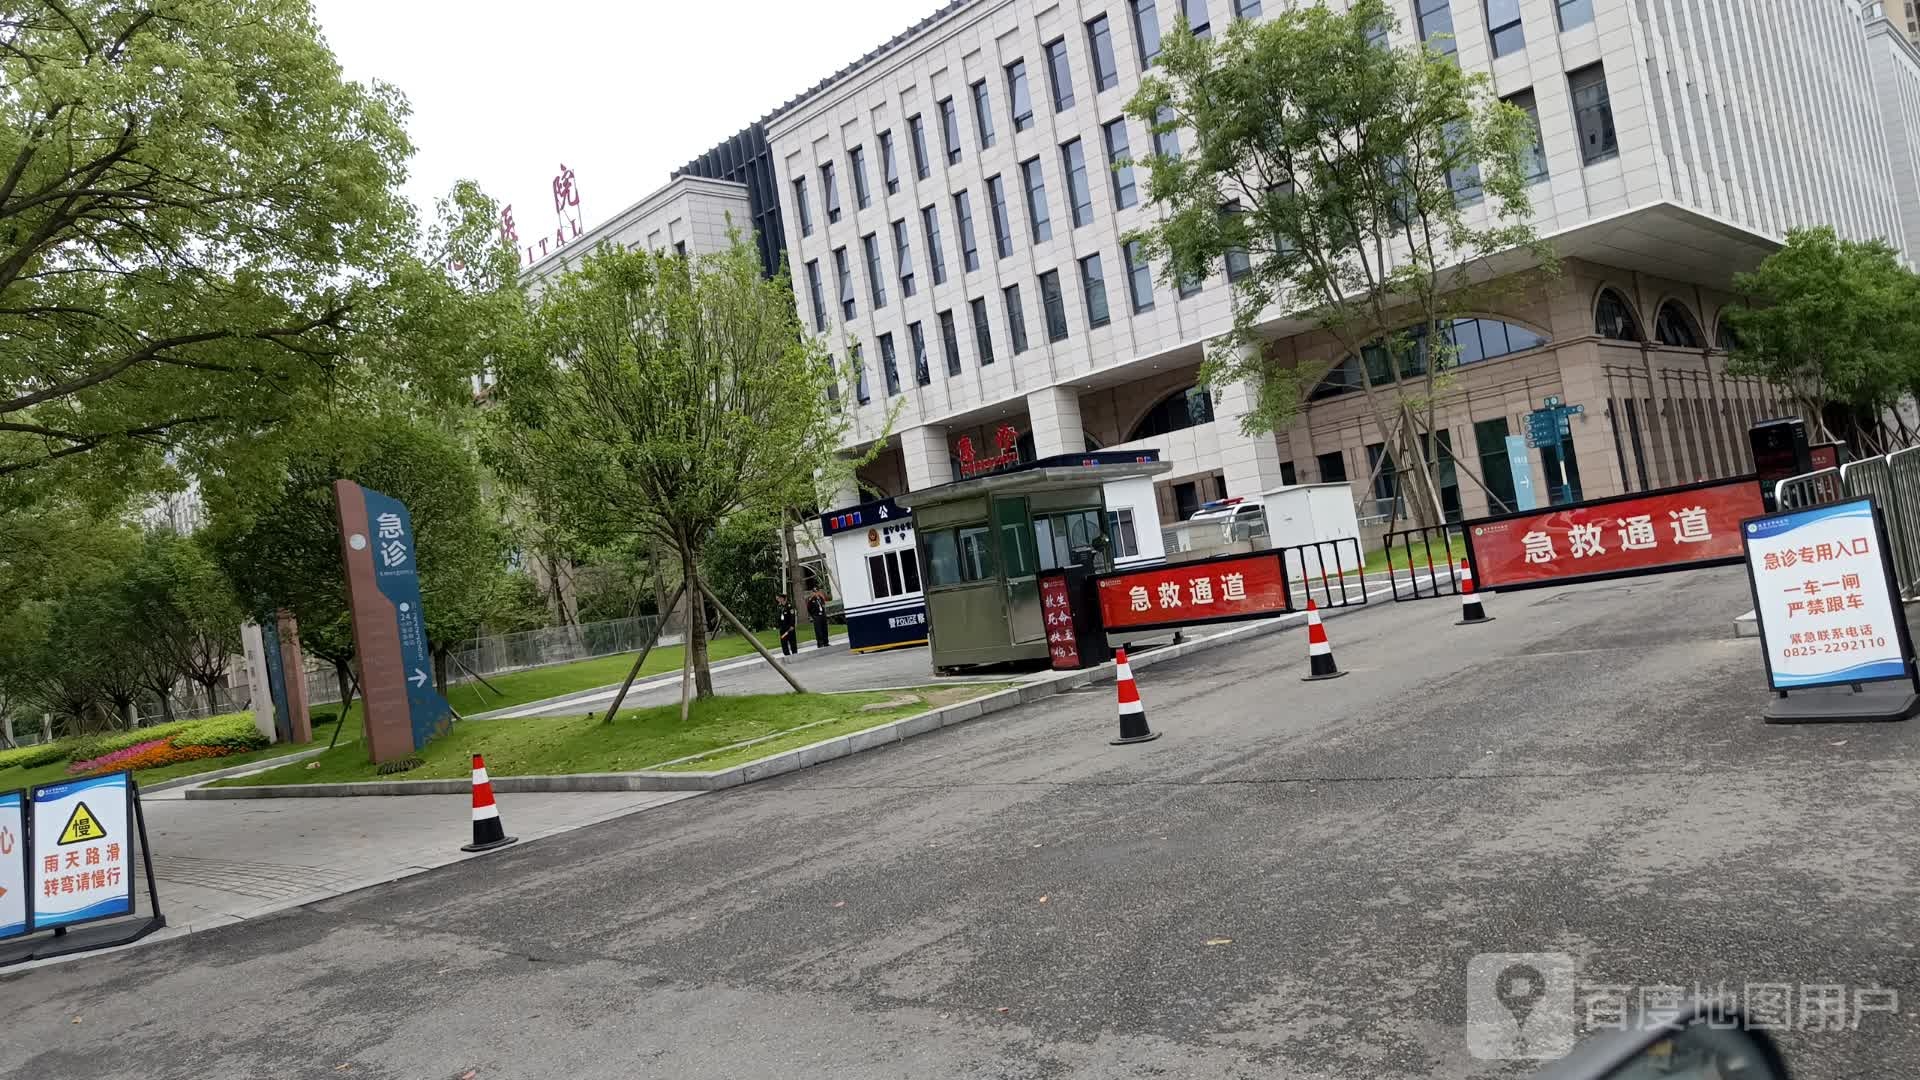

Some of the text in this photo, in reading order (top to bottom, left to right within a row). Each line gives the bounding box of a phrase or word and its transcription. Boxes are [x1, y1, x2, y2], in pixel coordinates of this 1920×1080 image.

[376, 512, 408, 567] 急诊
[1521, 506, 1712, 564] 急救通道
[1763, 537, 1869, 571] 急诊专用入口
[1129, 572, 1247, 612] 急救通道
[1784, 573, 1861, 596] 一车一闸
[1787, 593, 1865, 618] 严禁跟车
[1783, 637, 1886, 658] 0825-2292110
[1790, 624, 1873, 645] 紧急联系电话
[72, 818, 91, 838] 慢
[44, 843, 121, 873] 雨天路滑
[44, 867, 121, 897] 转弯请慢行
